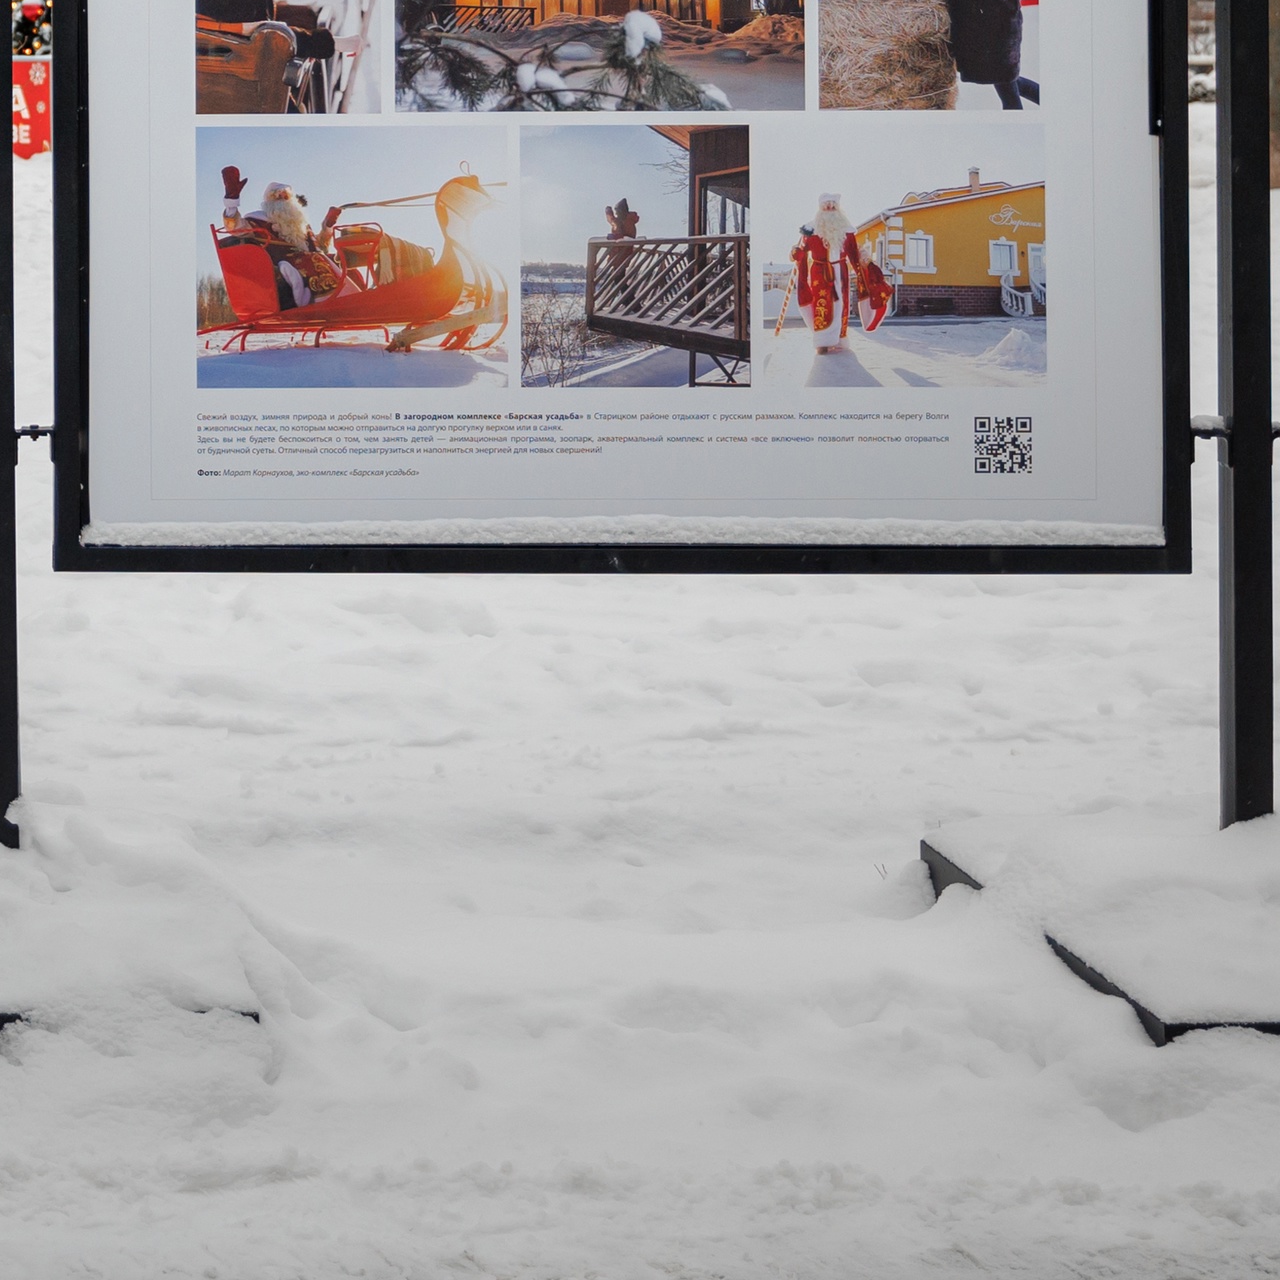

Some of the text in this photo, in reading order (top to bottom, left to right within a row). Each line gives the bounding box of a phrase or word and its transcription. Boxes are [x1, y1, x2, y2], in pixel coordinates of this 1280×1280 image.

[338, 413, 368, 421] добрый
[504, 413, 543, 421] «Барская
[546, 412, 584, 421] усадьба»
[594, 412, 637, 421] Старицком
[896, 412, 923, 421] берегу
[253, 469, 294, 478] Корнаухов,
[349, 469, 384, 477] «Барская
[385, 468, 419, 477] усадьба»
